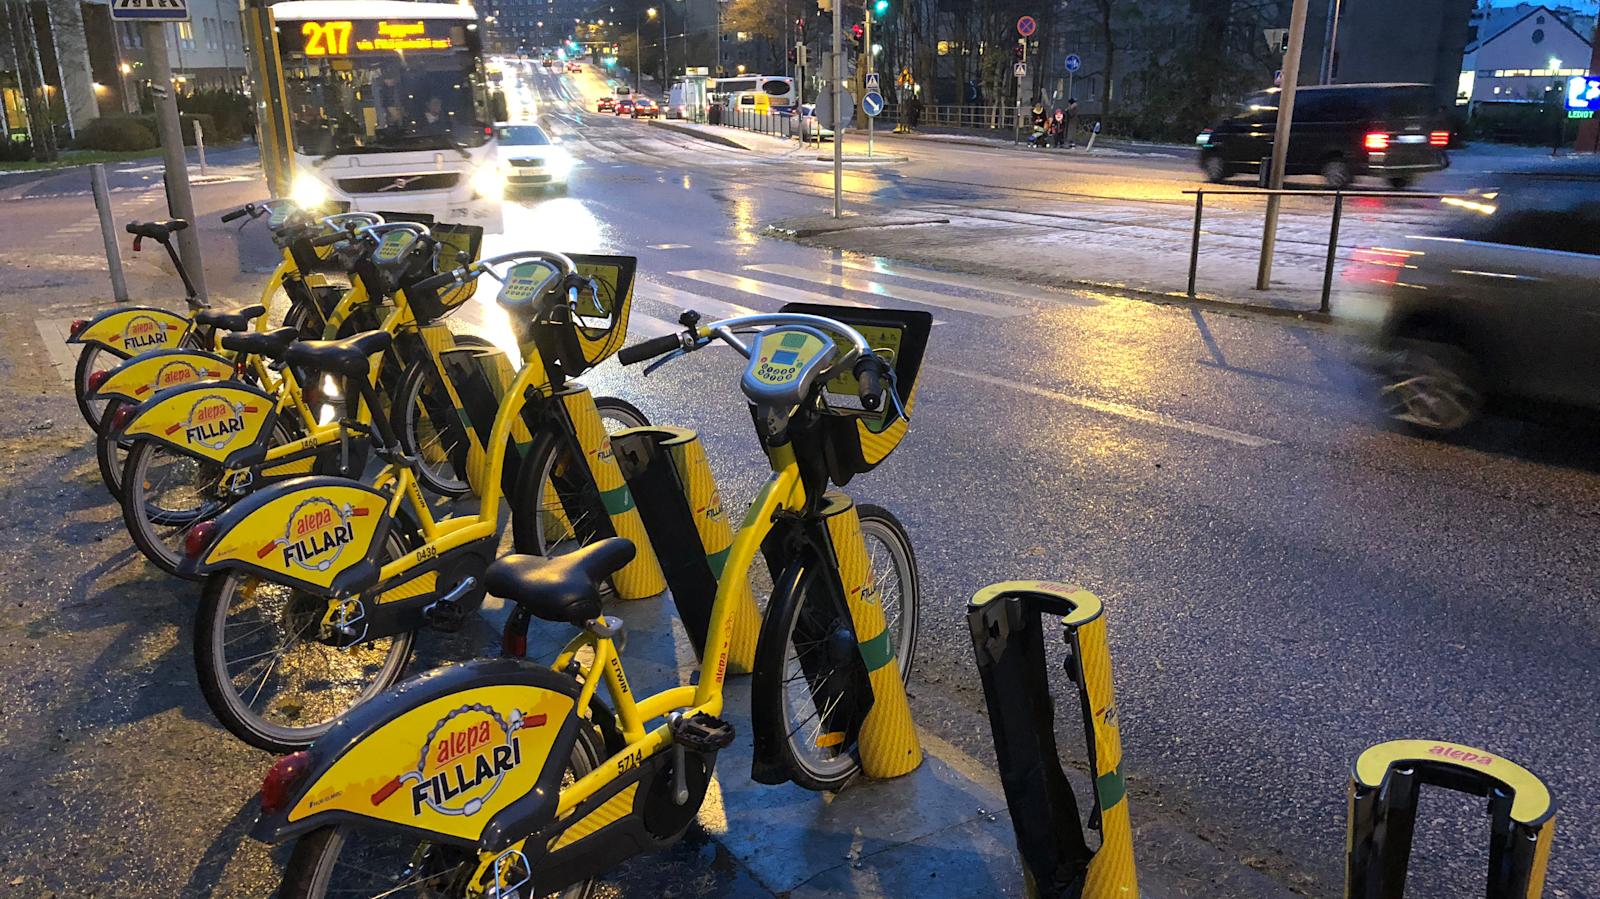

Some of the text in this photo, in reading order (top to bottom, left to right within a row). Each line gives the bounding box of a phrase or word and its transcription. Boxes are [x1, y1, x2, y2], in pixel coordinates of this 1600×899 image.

[302, 21, 352, 55] 217
[124, 332, 168, 349] FILLARI
[131, 322, 154, 334] alepa
[164, 368, 191, 384] alepa
[197, 402, 226, 421] alepa
[186, 416, 245, 444] FILLARI
[297, 508, 332, 534] alepa
[283, 522, 354, 568] FILLARI
[416, 545, 437, 562] 0436
[715, 652, 727, 684] alepa
[436, 720, 491, 764] alepa
[1430, 745, 1493, 765] alepa
[617, 748, 643, 776] 5714
[411, 737, 522, 817] FILLARI
